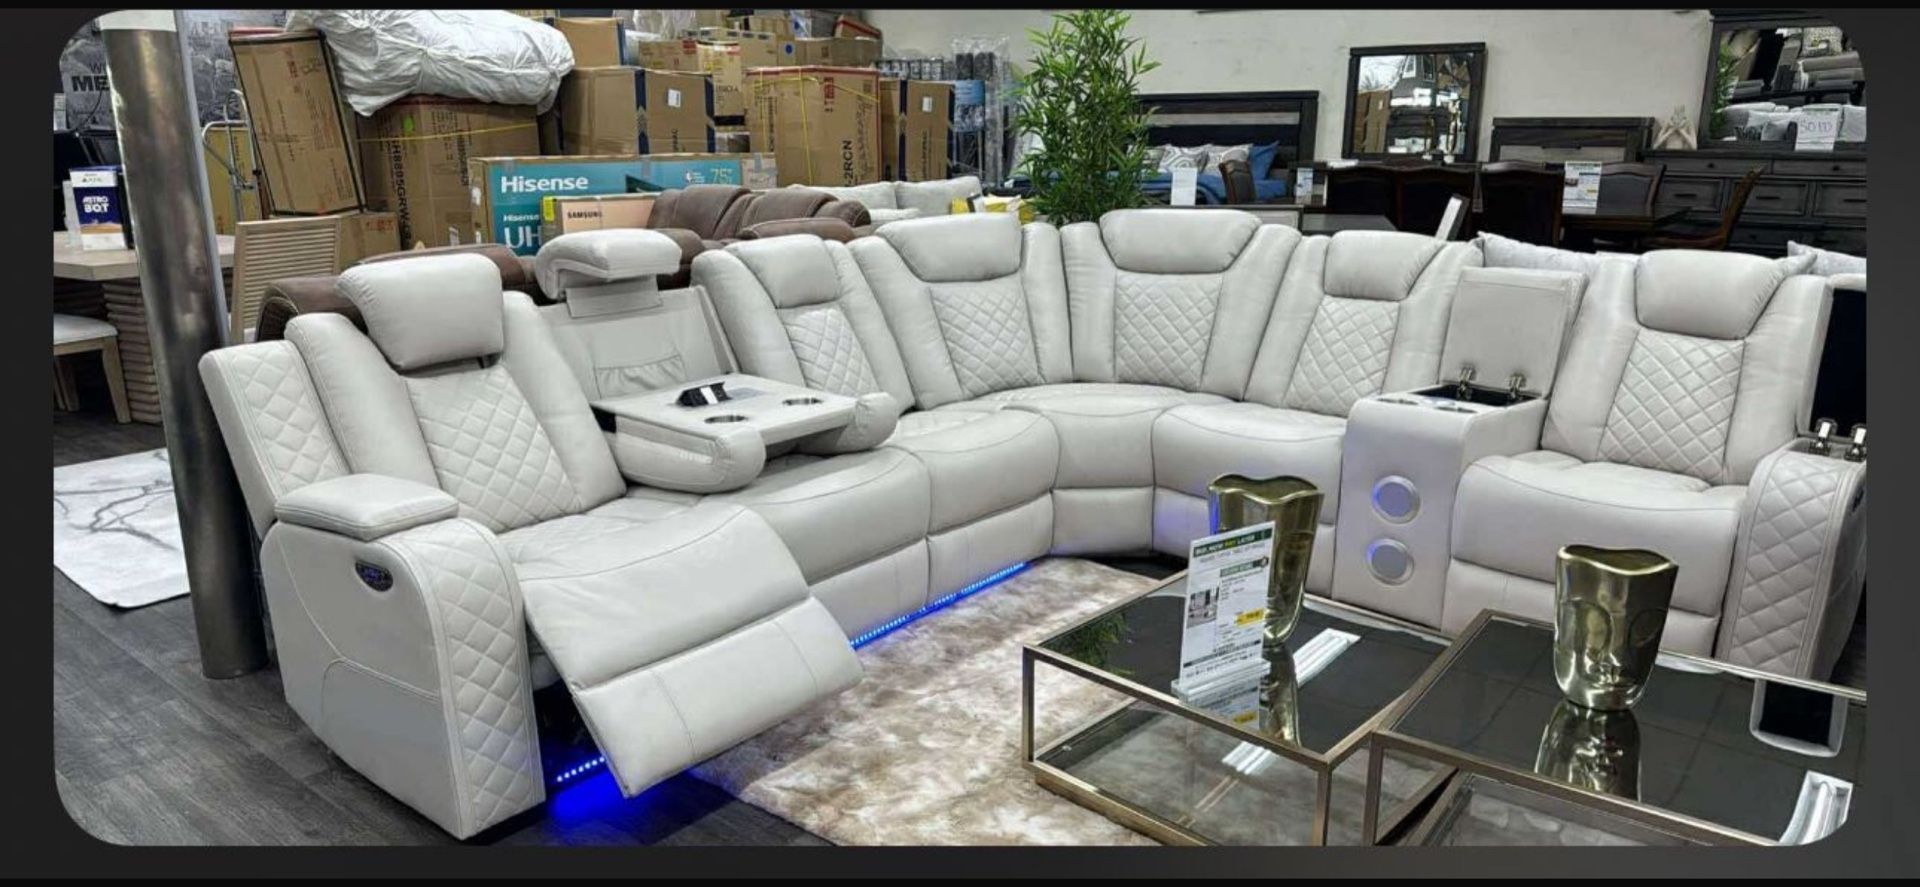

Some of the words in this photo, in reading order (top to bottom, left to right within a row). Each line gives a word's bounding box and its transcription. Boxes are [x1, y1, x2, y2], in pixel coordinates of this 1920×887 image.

[501, 175, 588, 193] Hisense
[84, 203, 109, 213] BOT
[503, 214, 540, 222] Hisense
